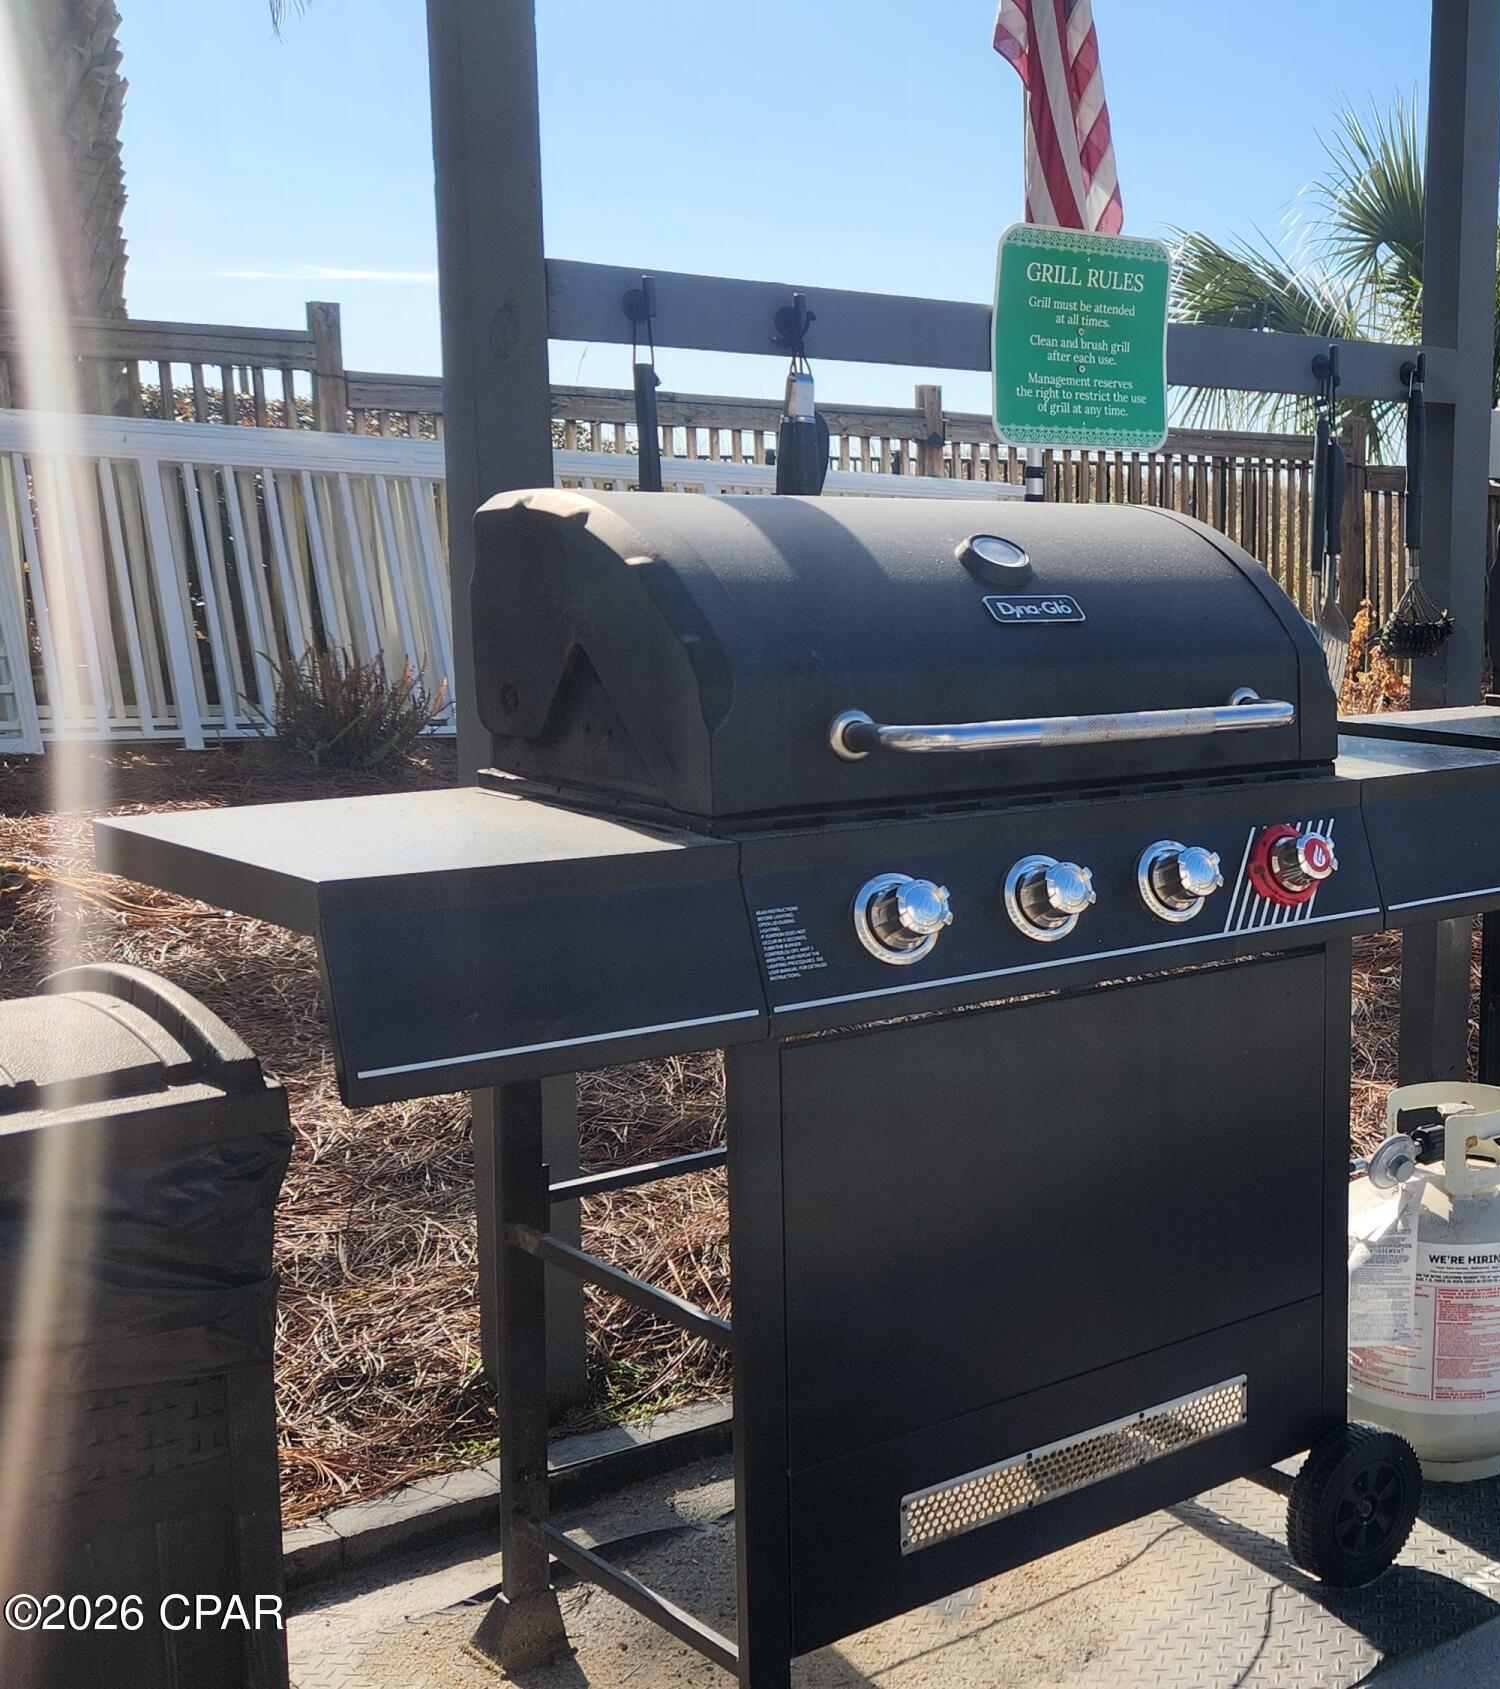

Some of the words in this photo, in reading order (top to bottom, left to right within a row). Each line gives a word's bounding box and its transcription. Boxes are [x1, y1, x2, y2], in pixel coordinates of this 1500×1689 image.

[1027, 262, 1082, 286] GRILL
[1087, 269, 1144, 292] RULES
[1028, 297, 1051, 308] Grill
[1053, 300, 1077, 312] must
[1080, 301, 1091, 312] be
[1094, 303, 1135, 316] attended
[1056, 314, 1065, 324] at
[1068, 314, 1079, 325] all
[1081, 315, 1110, 328] times.
[1030, 335, 1058, 347] Clean
[1060, 337, 1078, 349] and
[1081, 339, 1108, 351] brush
[1111, 342, 1130, 354] grill
[1047, 351, 1071, 362] after
[1074, 353, 1095, 364] each
[1098, 356, 1116, 366] use.
[1028, 373, 1090, 390] Management
[1094, 379, 1132, 389] reserves
[1016, 386, 1033, 397] the
[1036, 388, 1059, 401] right
[1062, 390, 1072, 400] to
[1075, 390, 1110, 402] restrict
[1113, 392, 1129, 403] the
[1131, 395, 1147, 404] use
[1038, 401, 1048, 412] of
[1050, 402, 1070, 415] grill
[1072, 404, 1082, 413] at
[1085, 406, 1102, 418] any
[1104, 405, 1128, 416] time.
[1429, 1254, 1465, 1264] WE'RE
